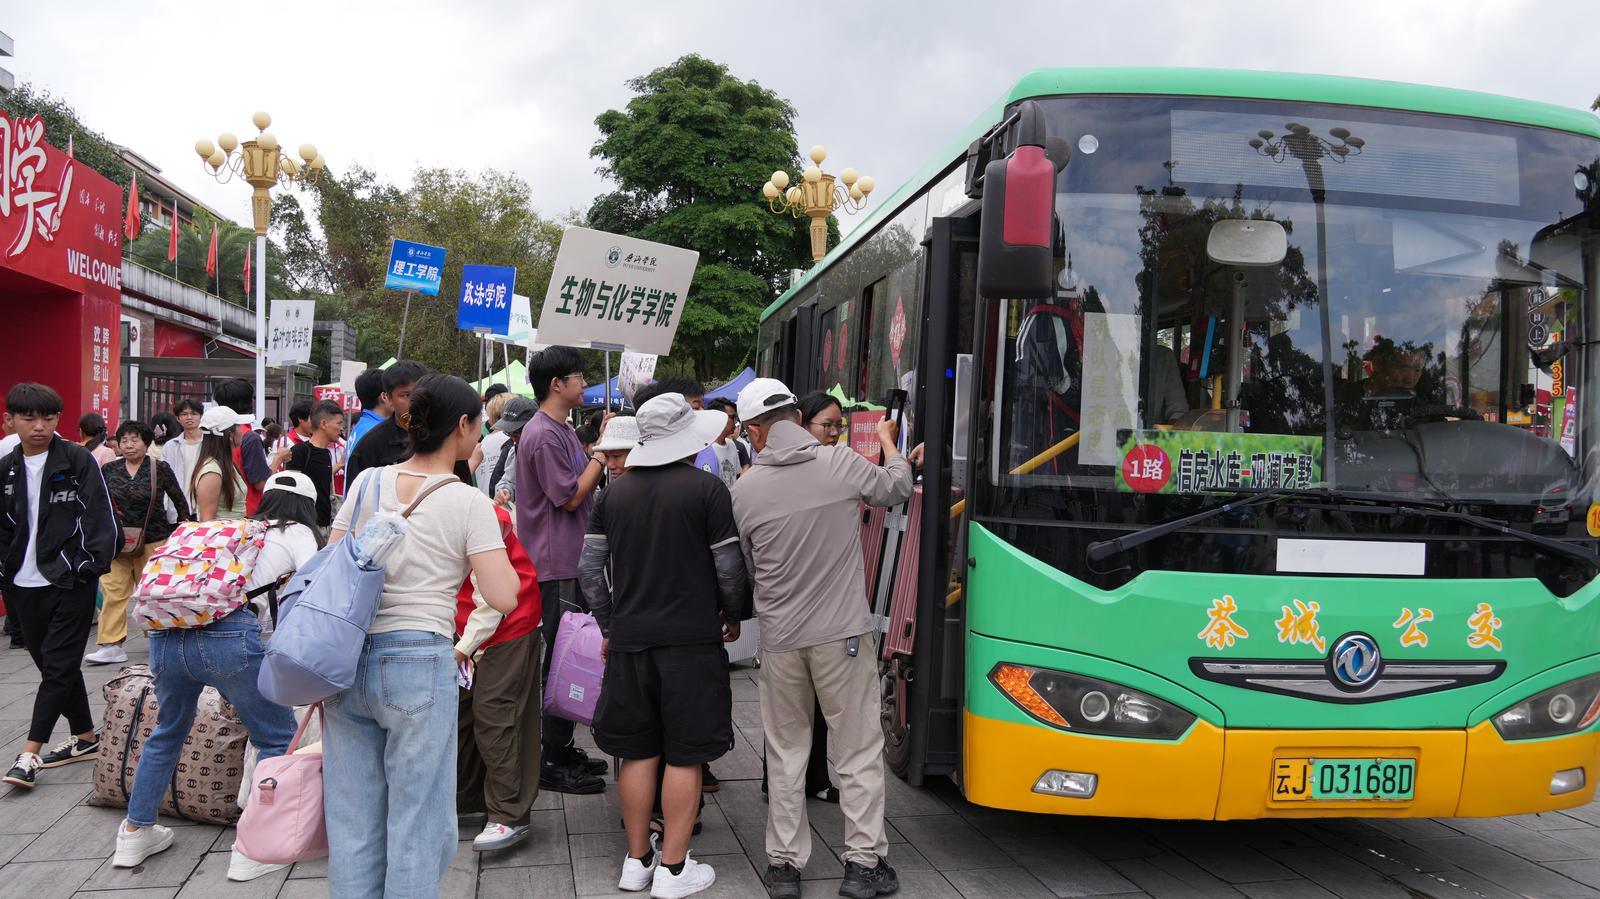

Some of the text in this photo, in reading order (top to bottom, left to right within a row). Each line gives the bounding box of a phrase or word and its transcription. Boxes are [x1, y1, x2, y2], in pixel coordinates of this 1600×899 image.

[67, 248, 121, 290] WELCOME
[392, 260, 439, 281] 理工学院
[462, 280, 506, 309] 政法学院
[555, 274, 678, 328] 生物与化学学院
[1129, 459, 1164, 480] 1路
[1198, 595, 1503, 653] 茶城公交
